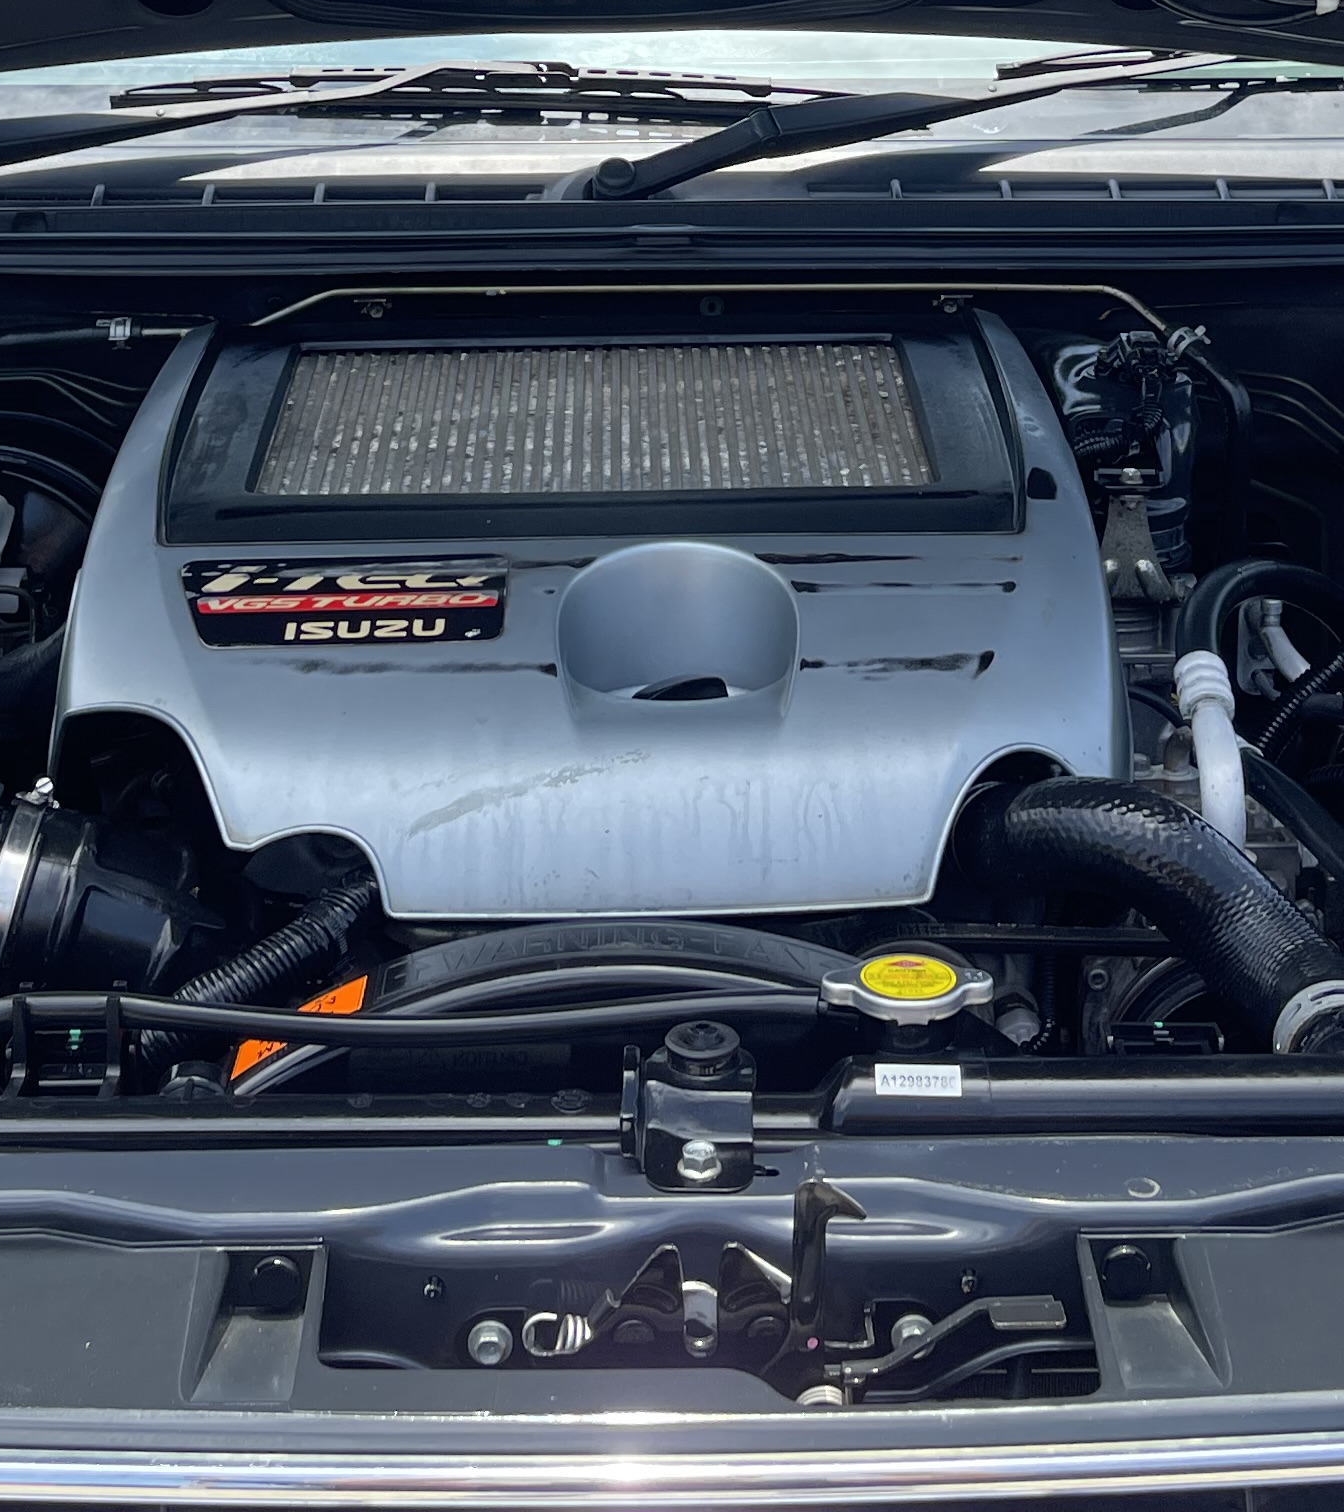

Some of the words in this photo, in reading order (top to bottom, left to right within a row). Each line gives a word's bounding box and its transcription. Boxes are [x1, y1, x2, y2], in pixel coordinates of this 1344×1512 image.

[205, 595, 302, 613] VGS
[308, 591, 492, 609] TURBO
[283, 617, 447, 642] ISUZU
